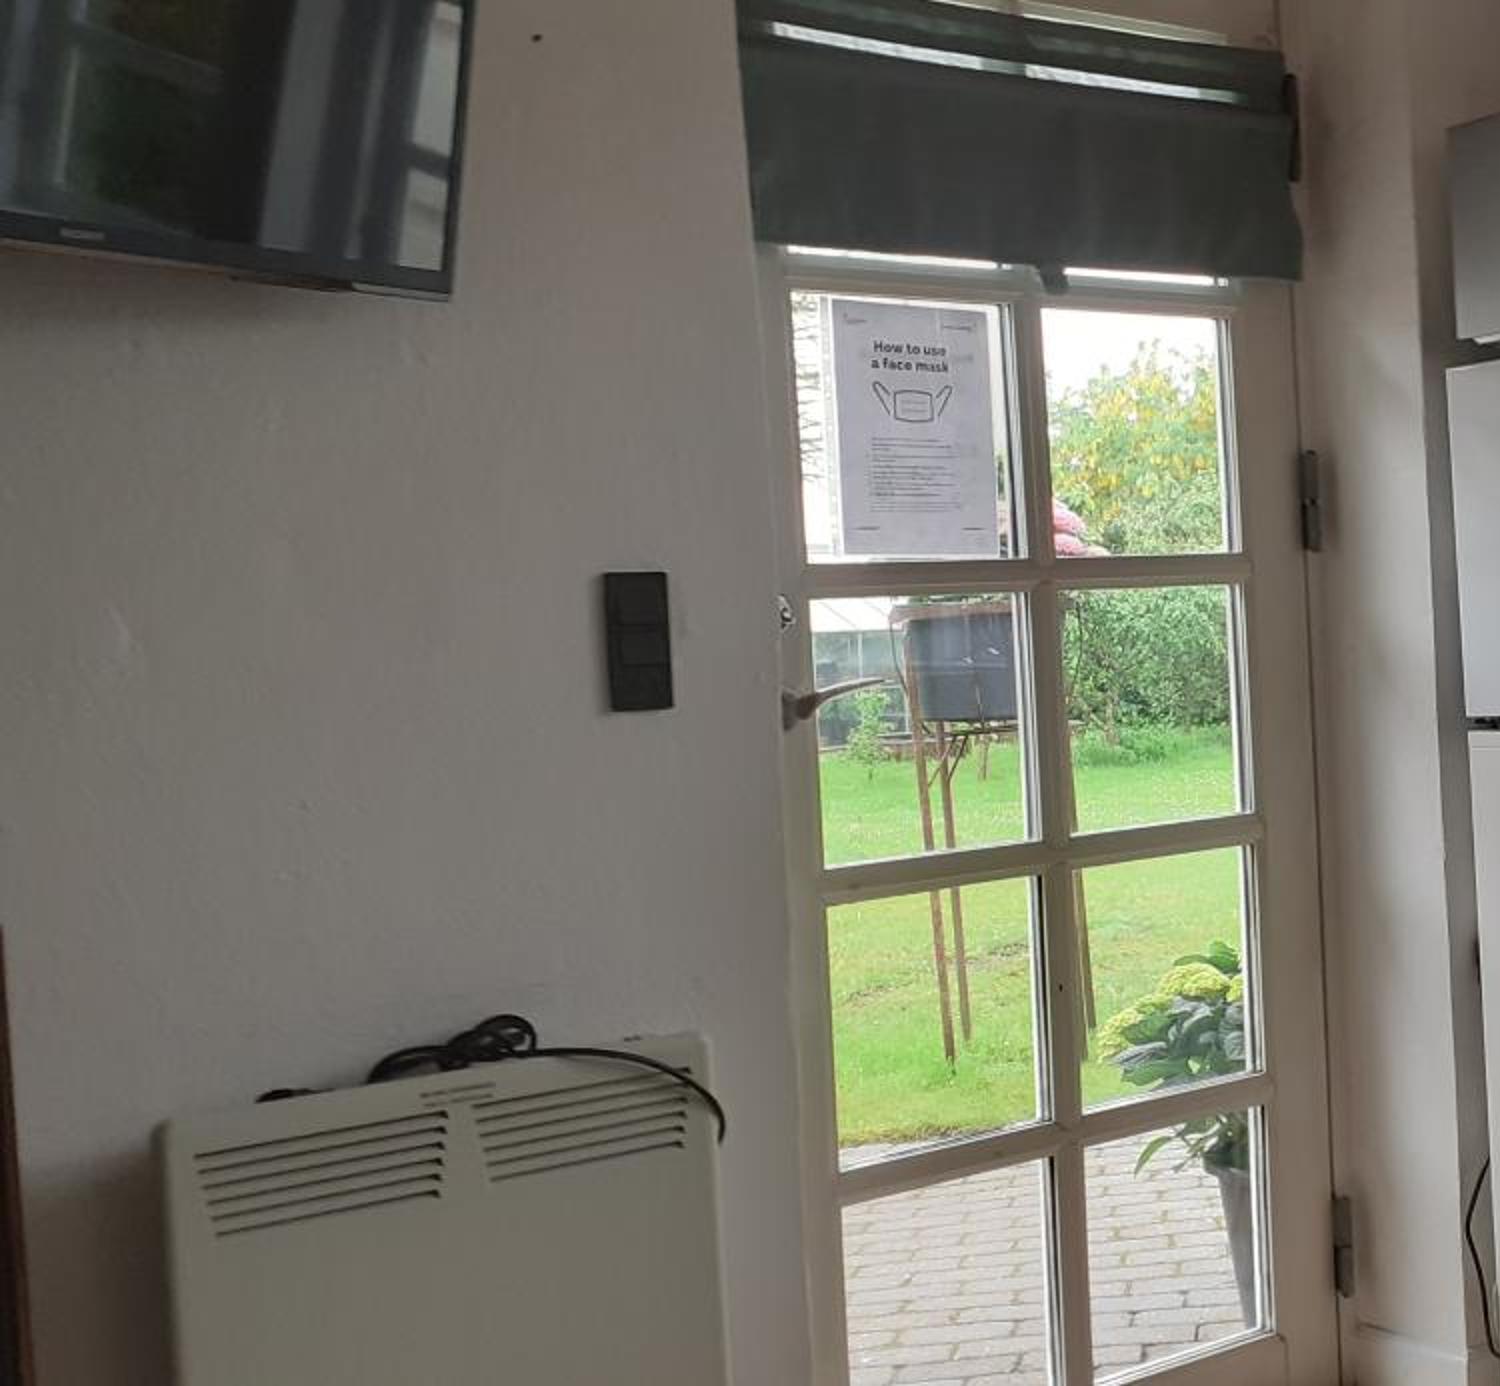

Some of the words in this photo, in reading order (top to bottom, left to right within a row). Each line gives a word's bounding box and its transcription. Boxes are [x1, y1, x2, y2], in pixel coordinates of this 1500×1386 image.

[873, 339, 903, 353] How
[906, 343, 921, 355] to
[923, 345, 947, 357] use
[870, 359, 880, 369] a
[883, 357, 913, 371] face
[915, 360, 949, 373] mask
